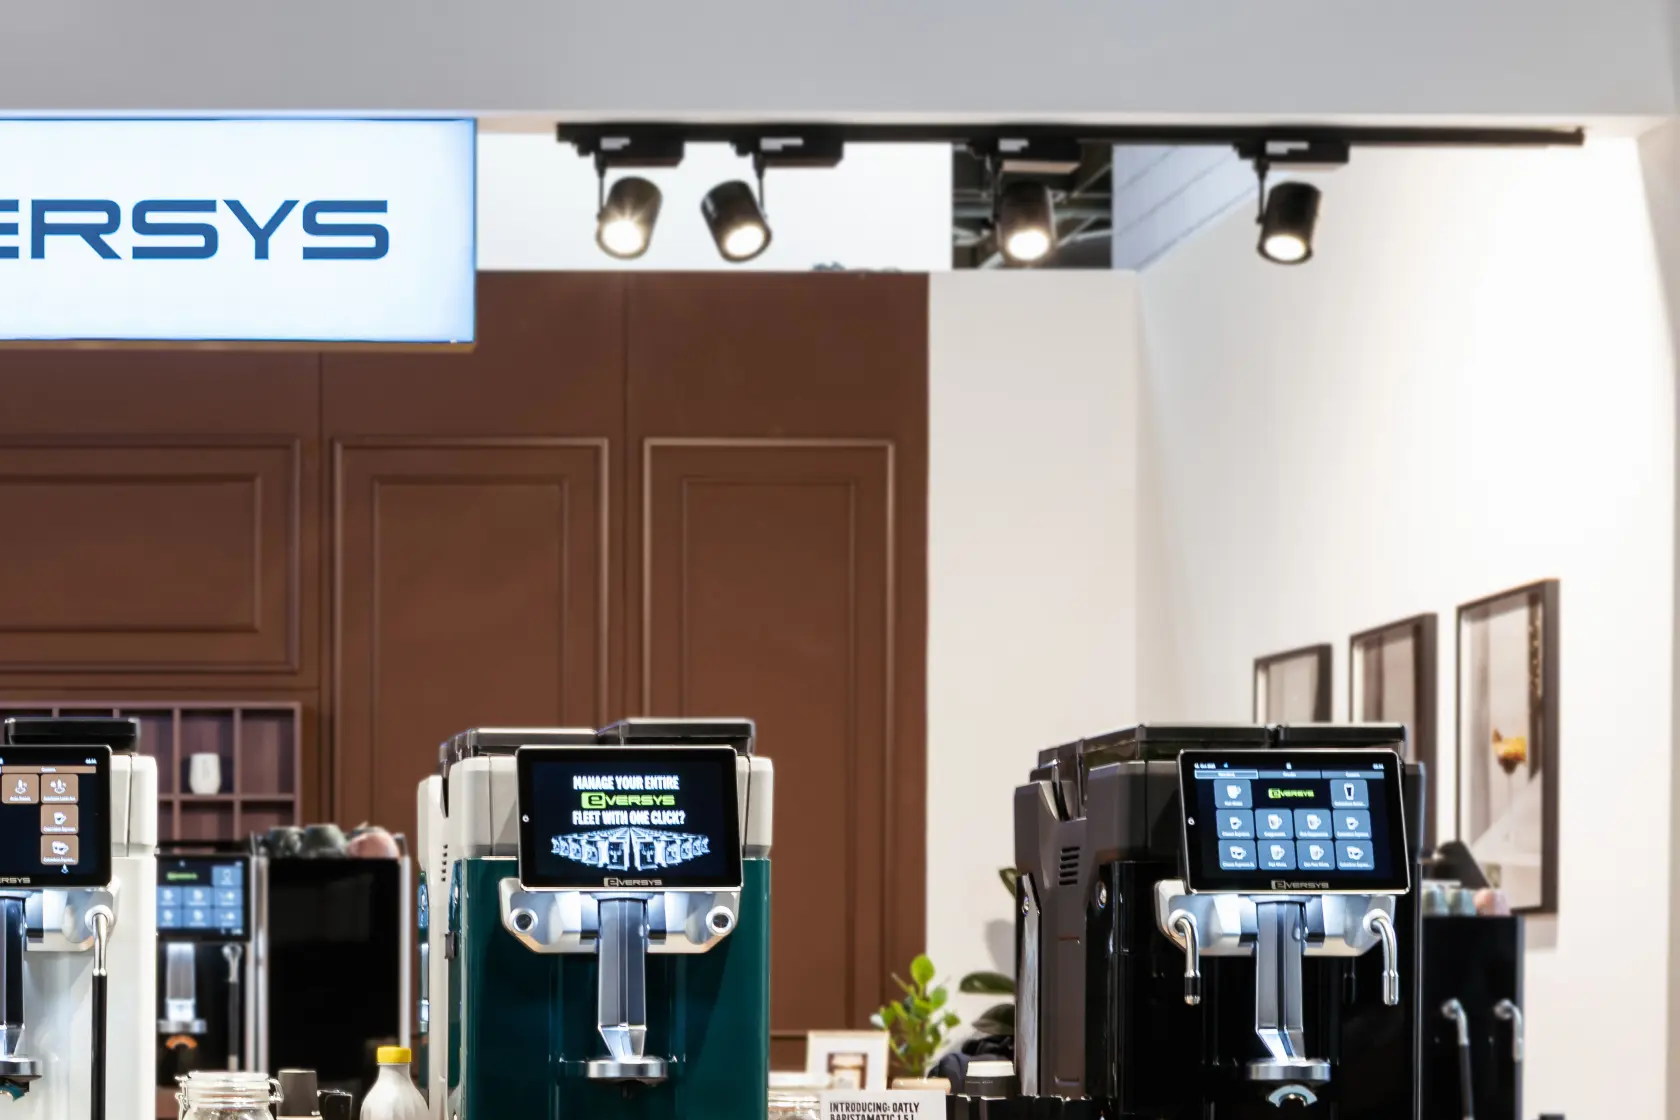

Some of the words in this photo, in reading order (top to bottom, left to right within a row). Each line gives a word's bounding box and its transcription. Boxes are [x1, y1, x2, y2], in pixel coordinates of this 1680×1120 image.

[573, 775, 614, 790] MANAGE
[615, 775, 644, 790] YOUR
[644, 775, 680, 790] ENTIRE
[572, 810, 601, 825] FLEET
[602, 810, 629, 825] WITH
[629, 810, 651, 825] ONE
[651, 810, 686, 825] CLICK?
[830, 1102, 890, 1113] INTRODUCING:
[893, 1102, 919, 1113] OATLY
